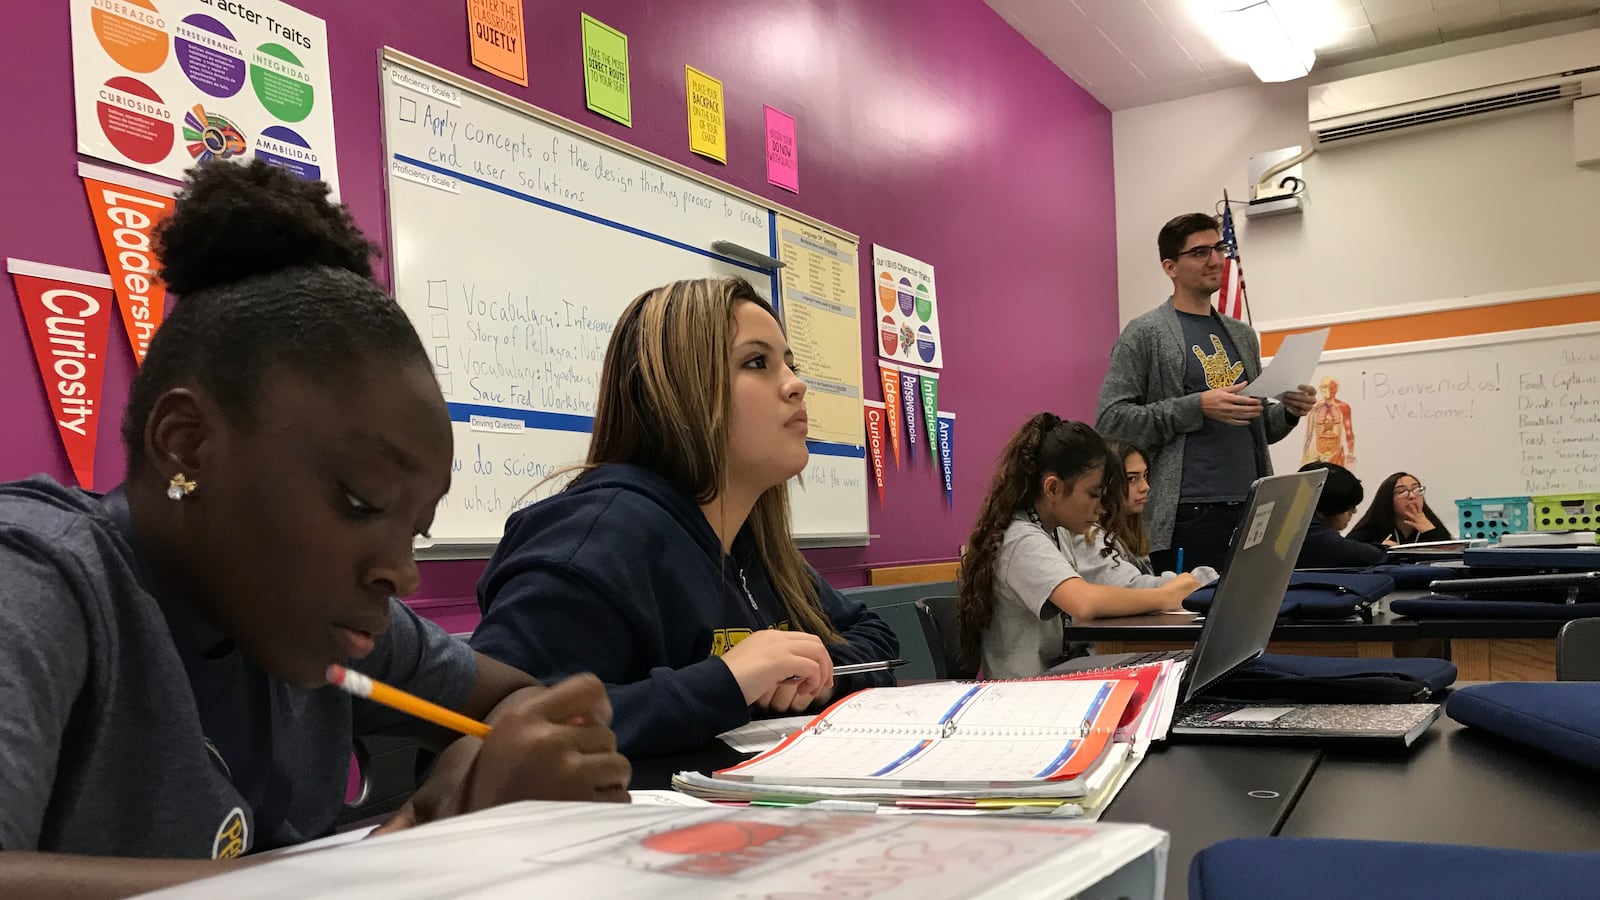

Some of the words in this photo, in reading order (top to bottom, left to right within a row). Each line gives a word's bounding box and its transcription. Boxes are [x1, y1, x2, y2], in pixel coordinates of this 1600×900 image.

[473, 5, 518, 37] CLASSROOM
[500, 1, 516, 21] THE
[176, 26, 243, 56] PERSEVERANCIA
[266, 16, 311, 49] Traits
[476, 22, 516, 54] QUIETLY
[252, 54, 310, 82] INTEGRIDAD
[588, 46, 601, 60] TAKE
[602, 52, 611, 65] THE
[611, 57, 625, 72] MOST
[588, 58, 608, 75] DIRECT
[609, 67, 625, 86] ROUTE
[392, 70, 431, 92] Proficiency
[431, 82, 450, 99] Scale
[590, 69, 599, 82] TO
[600, 73, 613, 88] YOUR
[613, 79, 625, 95] SEAT
[99, 90, 171, 119] CURIOSIDAD
[692, 91, 720, 114] BACKPACK
[256, 138, 318, 162] AMABILIDAD
[428, 144, 461, 169] end
[473, 159, 505, 180] user
[392, 162, 430, 182] Proficiency
[431, 173, 450, 189] Scale
[423, 104, 457, 141] Apply
[542, 137, 559, 163] of
[568, 143, 590, 171] the
[594, 156, 633, 193] design
[640, 169, 679, 207] thinking
[682, 191, 713, 214] process
[723, 197, 732, 218] to
[740, 211, 764, 229] create
[462, 283, 560, 328] Vocabulary:
[466, 320, 499, 359] Story
[503, 325, 518, 348] of
[525, 321, 578, 363] Pellagra:
[40, 288, 100, 436] Curiosity
[459, 345, 541, 381] Vocabulary:
[469, 376, 506, 403] Save
[510, 385, 535, 409] Fred
[1519, 372, 1547, 391] Food
[471, 418, 493, 430] Driving
[903, 375, 917, 444] Perseverancia
[923, 379, 937, 451] Integridad
[868, 410, 883, 487] Curiosidad
[1518, 431, 1547, 446] Trash
[474, 443, 493, 476] do
[939, 421, 953, 491] Amabilidad
[464, 486, 502, 513] which
